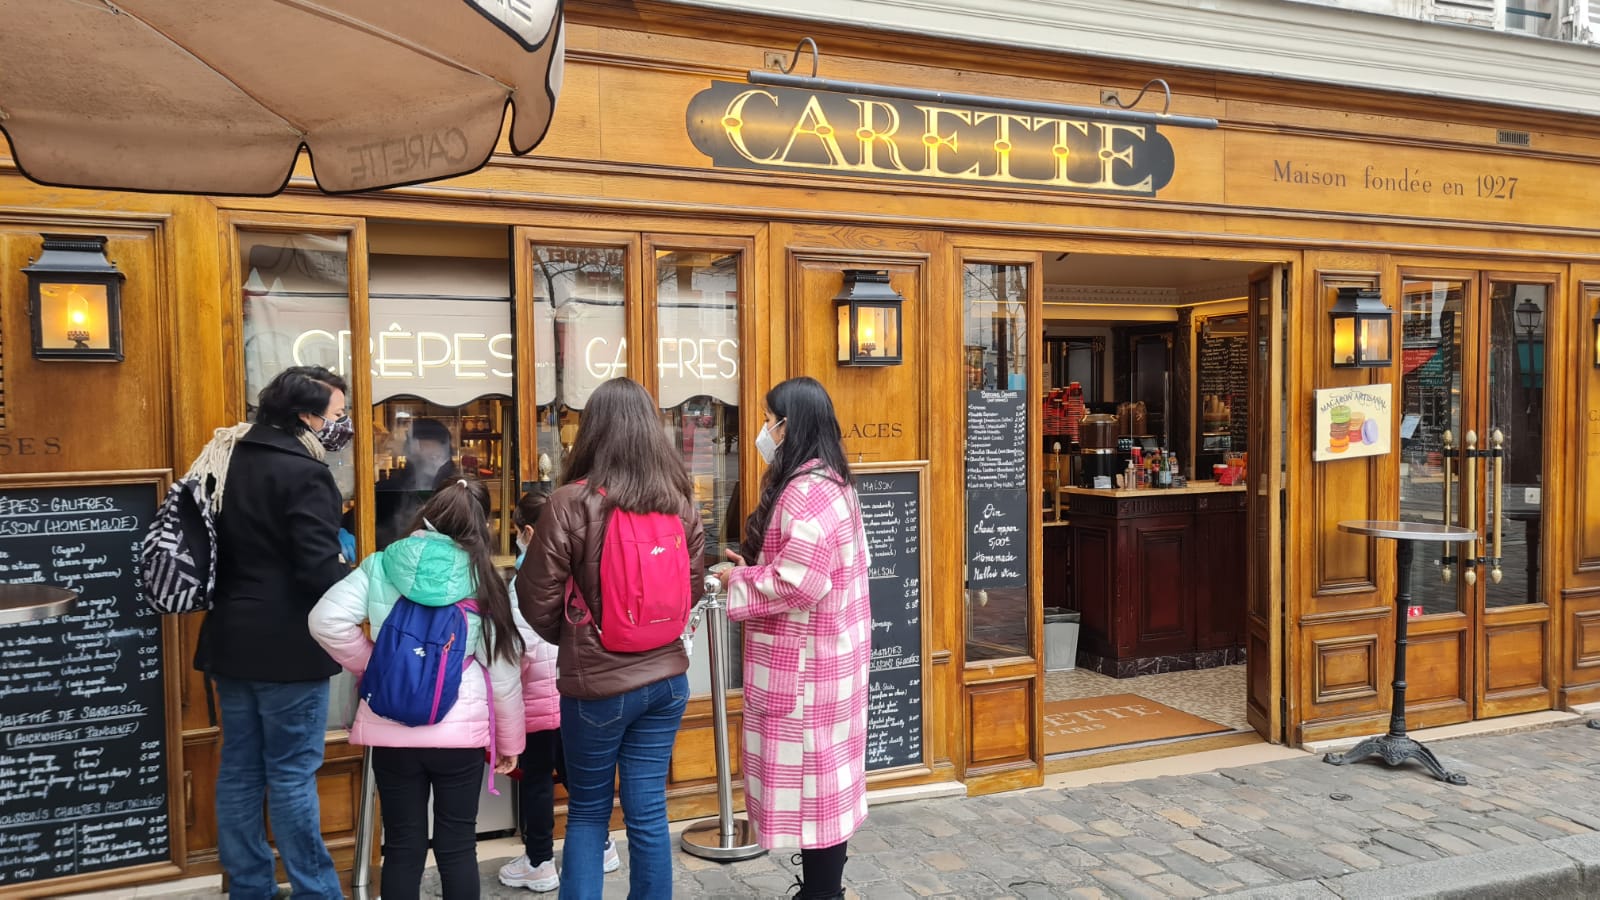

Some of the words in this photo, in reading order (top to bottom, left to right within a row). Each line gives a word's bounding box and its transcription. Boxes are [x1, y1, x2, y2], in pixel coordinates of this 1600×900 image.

[721, 89, 1153, 192] CARETTE
[1273, 159, 1346, 187] Maison
[1364, 165, 1432, 193] fondée
[1443, 179, 1464, 196] en
[1477, 175, 1518, 200] 1927
[585, 336, 738, 379] GAFRES
[51, 497, 114, 512] GAUFRES
[57, 708, 75, 723] DE
[1044, 704, 1160, 728] ETTE
[1047, 723, 1107, 737] PARIS
